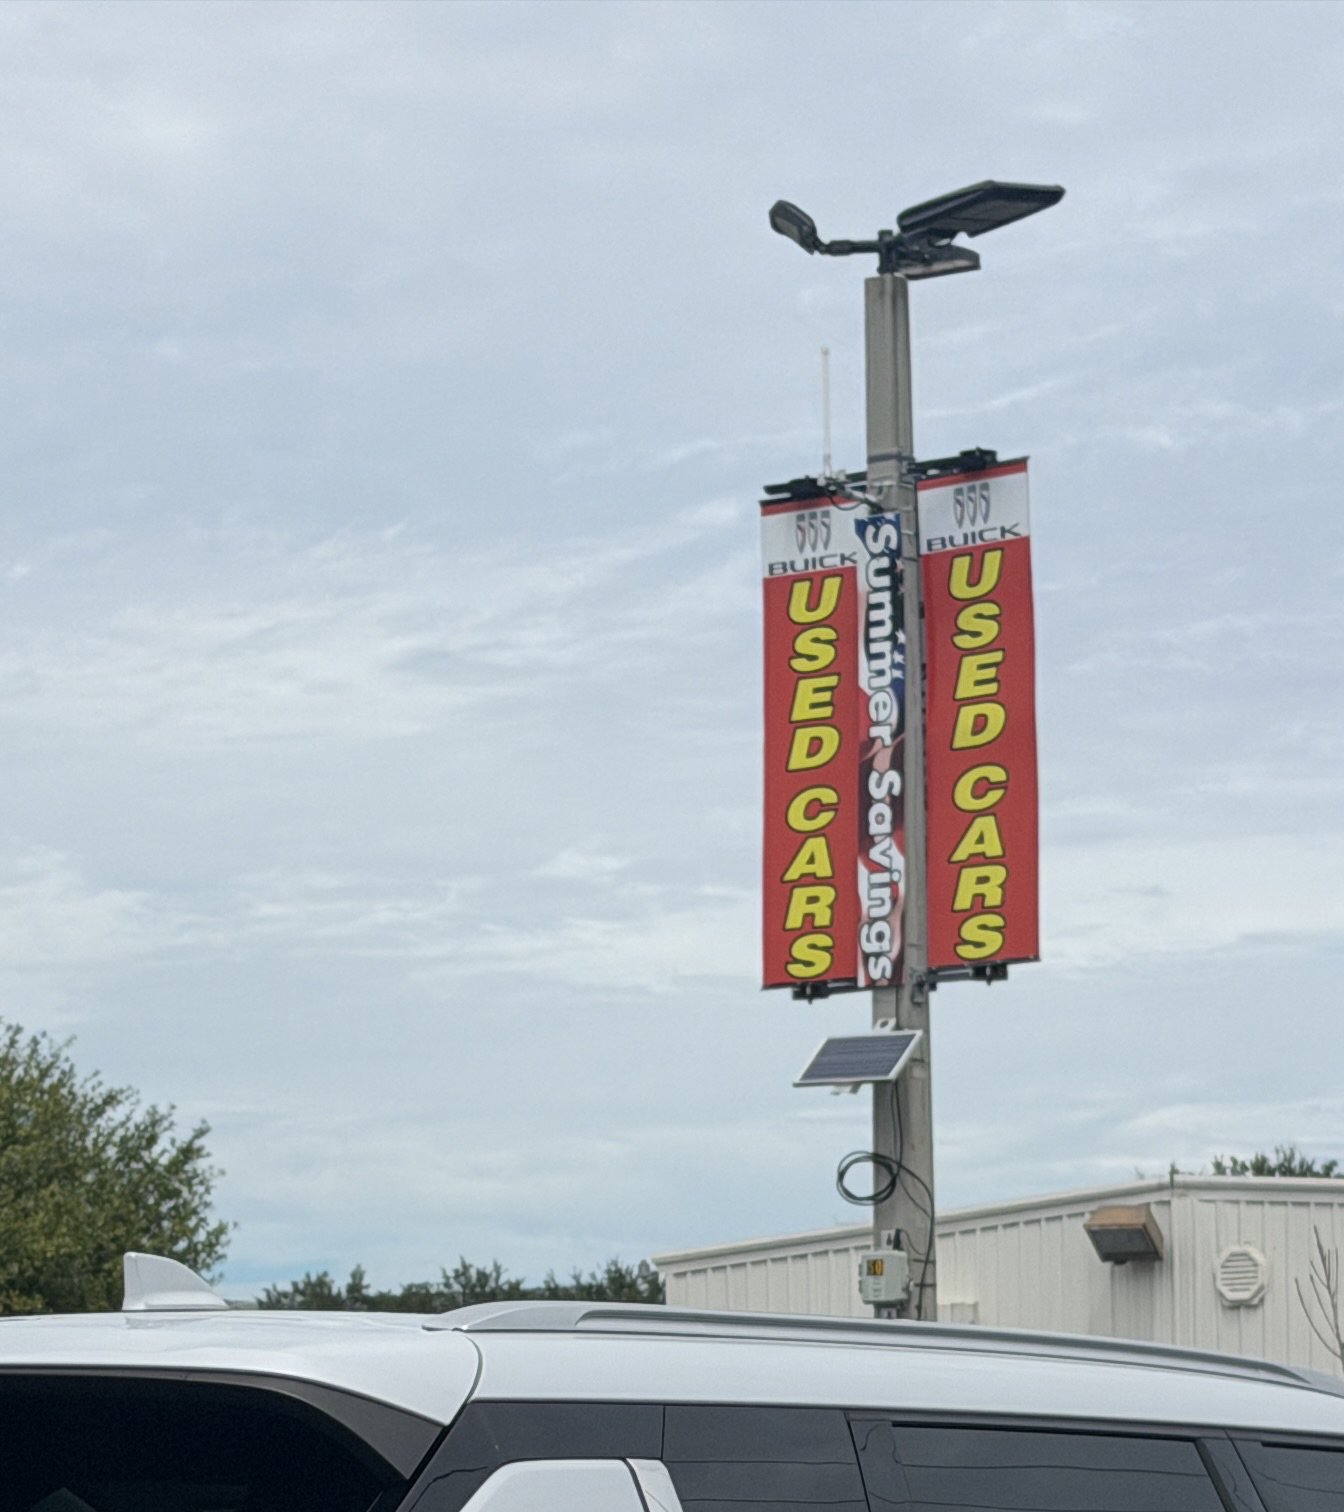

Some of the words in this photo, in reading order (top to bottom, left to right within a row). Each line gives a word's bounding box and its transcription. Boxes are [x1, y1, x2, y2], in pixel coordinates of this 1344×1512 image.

[768, 552, 858, 576] BUICK
[865, 523, 899, 748] Summer
[926, 522, 1021, 552] BUICK
[787, 574, 844, 773] USED
[948, 547, 1008, 750] USED
[781, 784, 840, 979] CARS
[860, 768, 902, 982] Savings
[948, 763, 1009, 961] CARS
